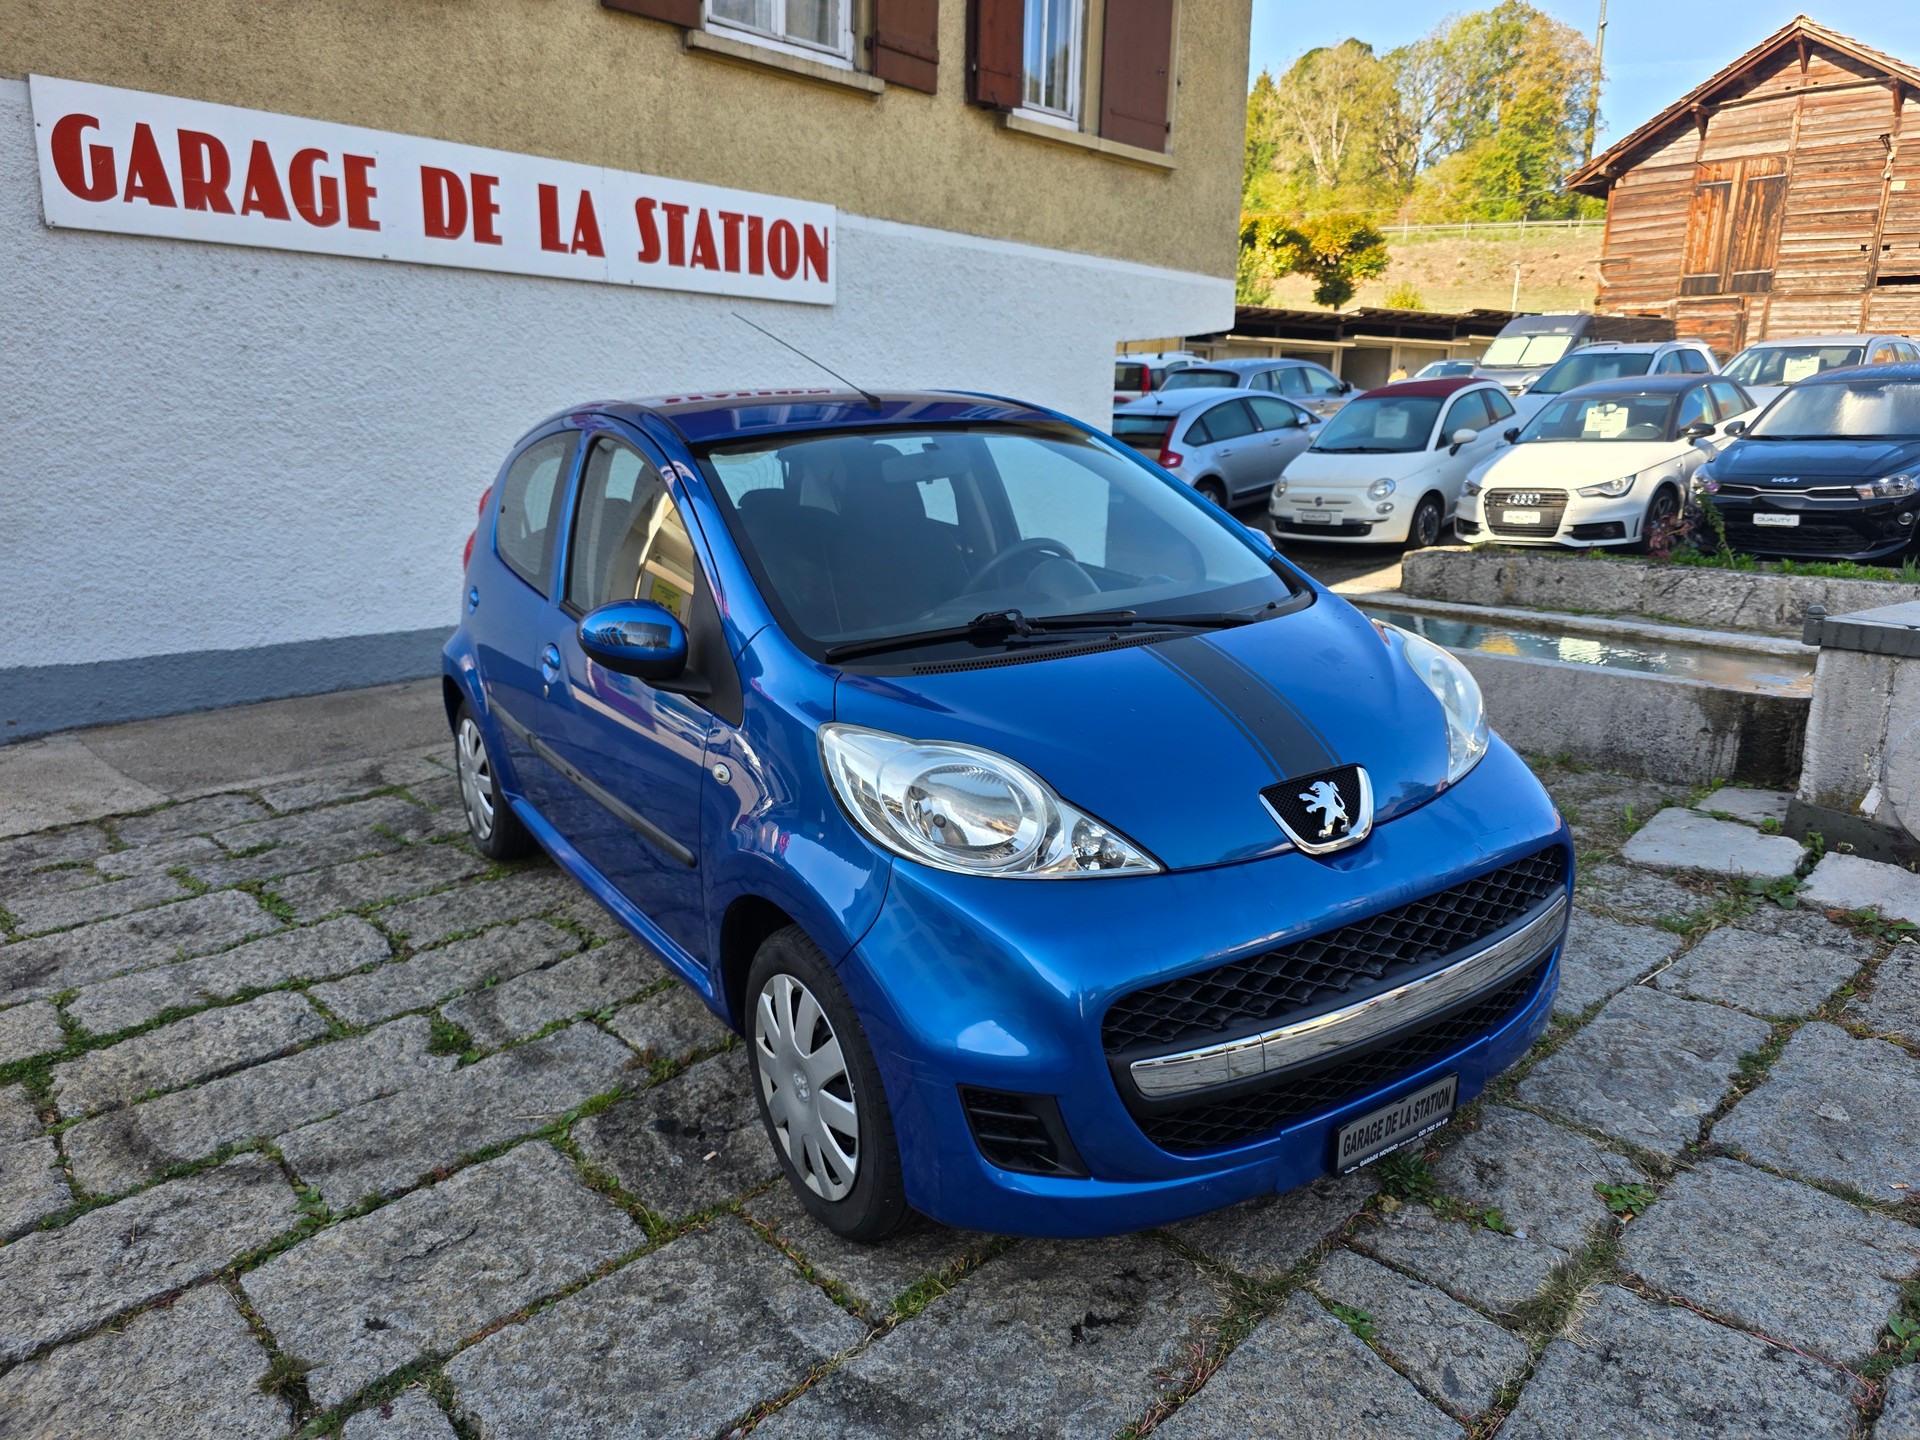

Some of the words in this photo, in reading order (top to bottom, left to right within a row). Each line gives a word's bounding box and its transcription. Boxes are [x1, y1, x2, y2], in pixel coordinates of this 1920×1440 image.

[51, 113, 381, 232] GARAGE
[420, 165, 503, 246] DE
[537, 183, 605, 258] LA
[635, 196, 829, 285] STATION
[1343, 1118, 1383, 1157] GARAGE
[1384, 1111, 1399, 1137] DE
[1399, 1105, 1412, 1130] LA
[1413, 1085, 1451, 1123] STATION
